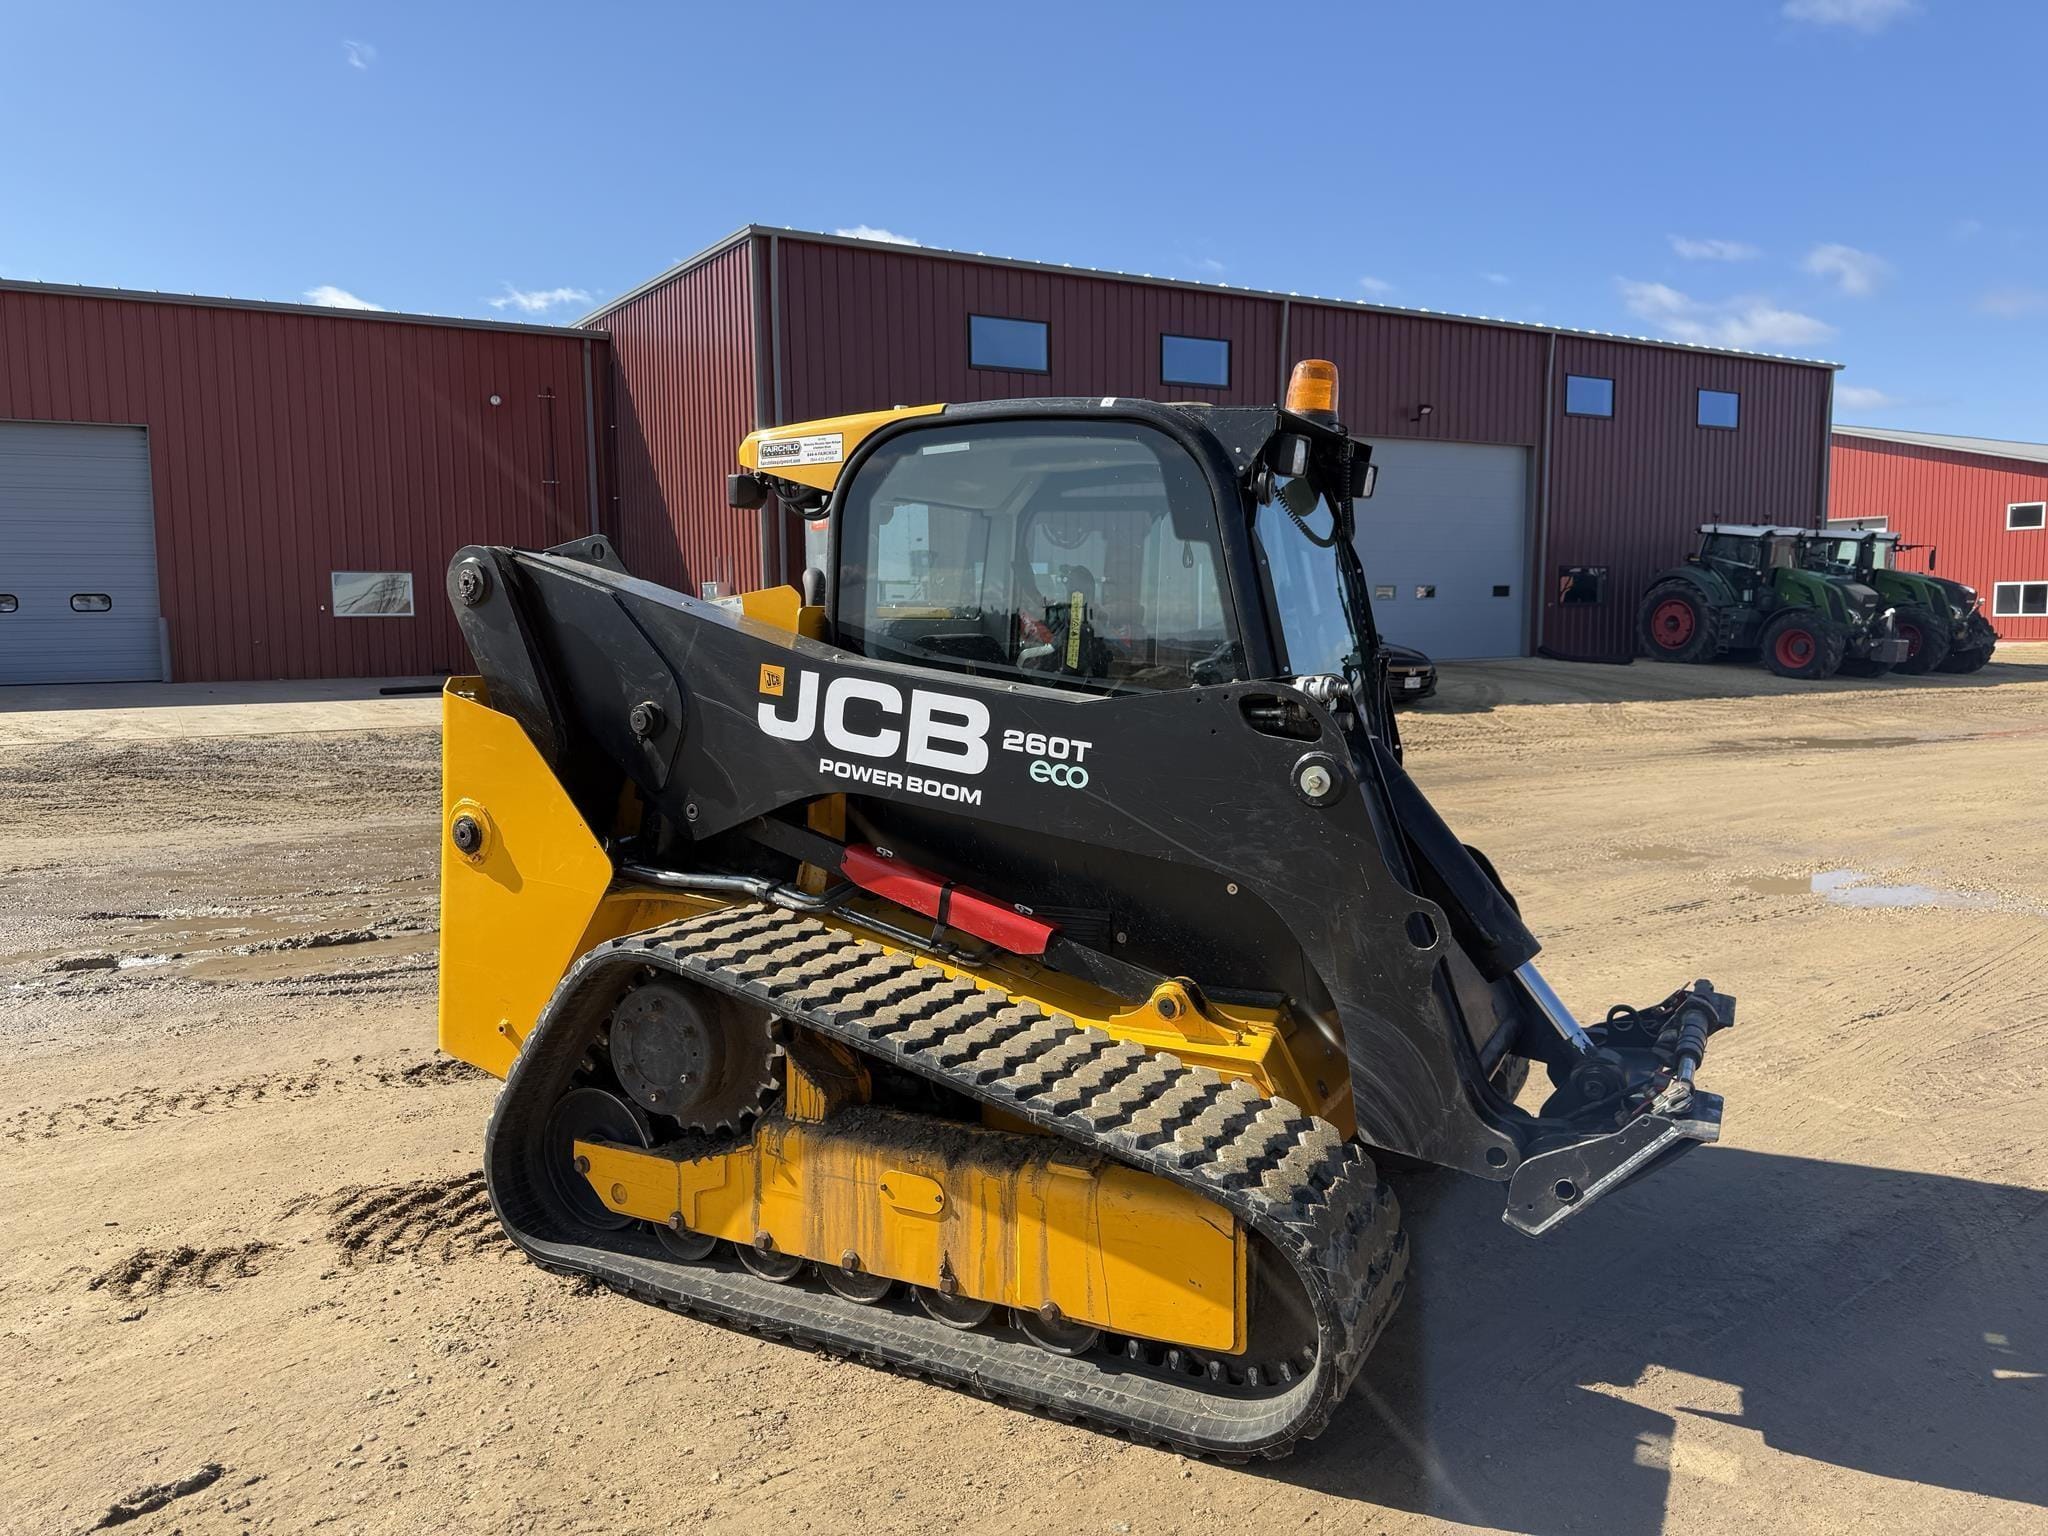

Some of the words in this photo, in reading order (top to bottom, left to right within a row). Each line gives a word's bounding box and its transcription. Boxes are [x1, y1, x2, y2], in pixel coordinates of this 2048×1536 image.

[763, 443, 799, 453] FAIRCHILD
[766, 672, 781, 687] JCB
[758, 670, 990, 775] JCB
[1002, 729, 1093, 762] 260T
[819, 758, 903, 790] POWER
[906, 776, 983, 806] BOOM
[1029, 760, 1089, 789] eco
